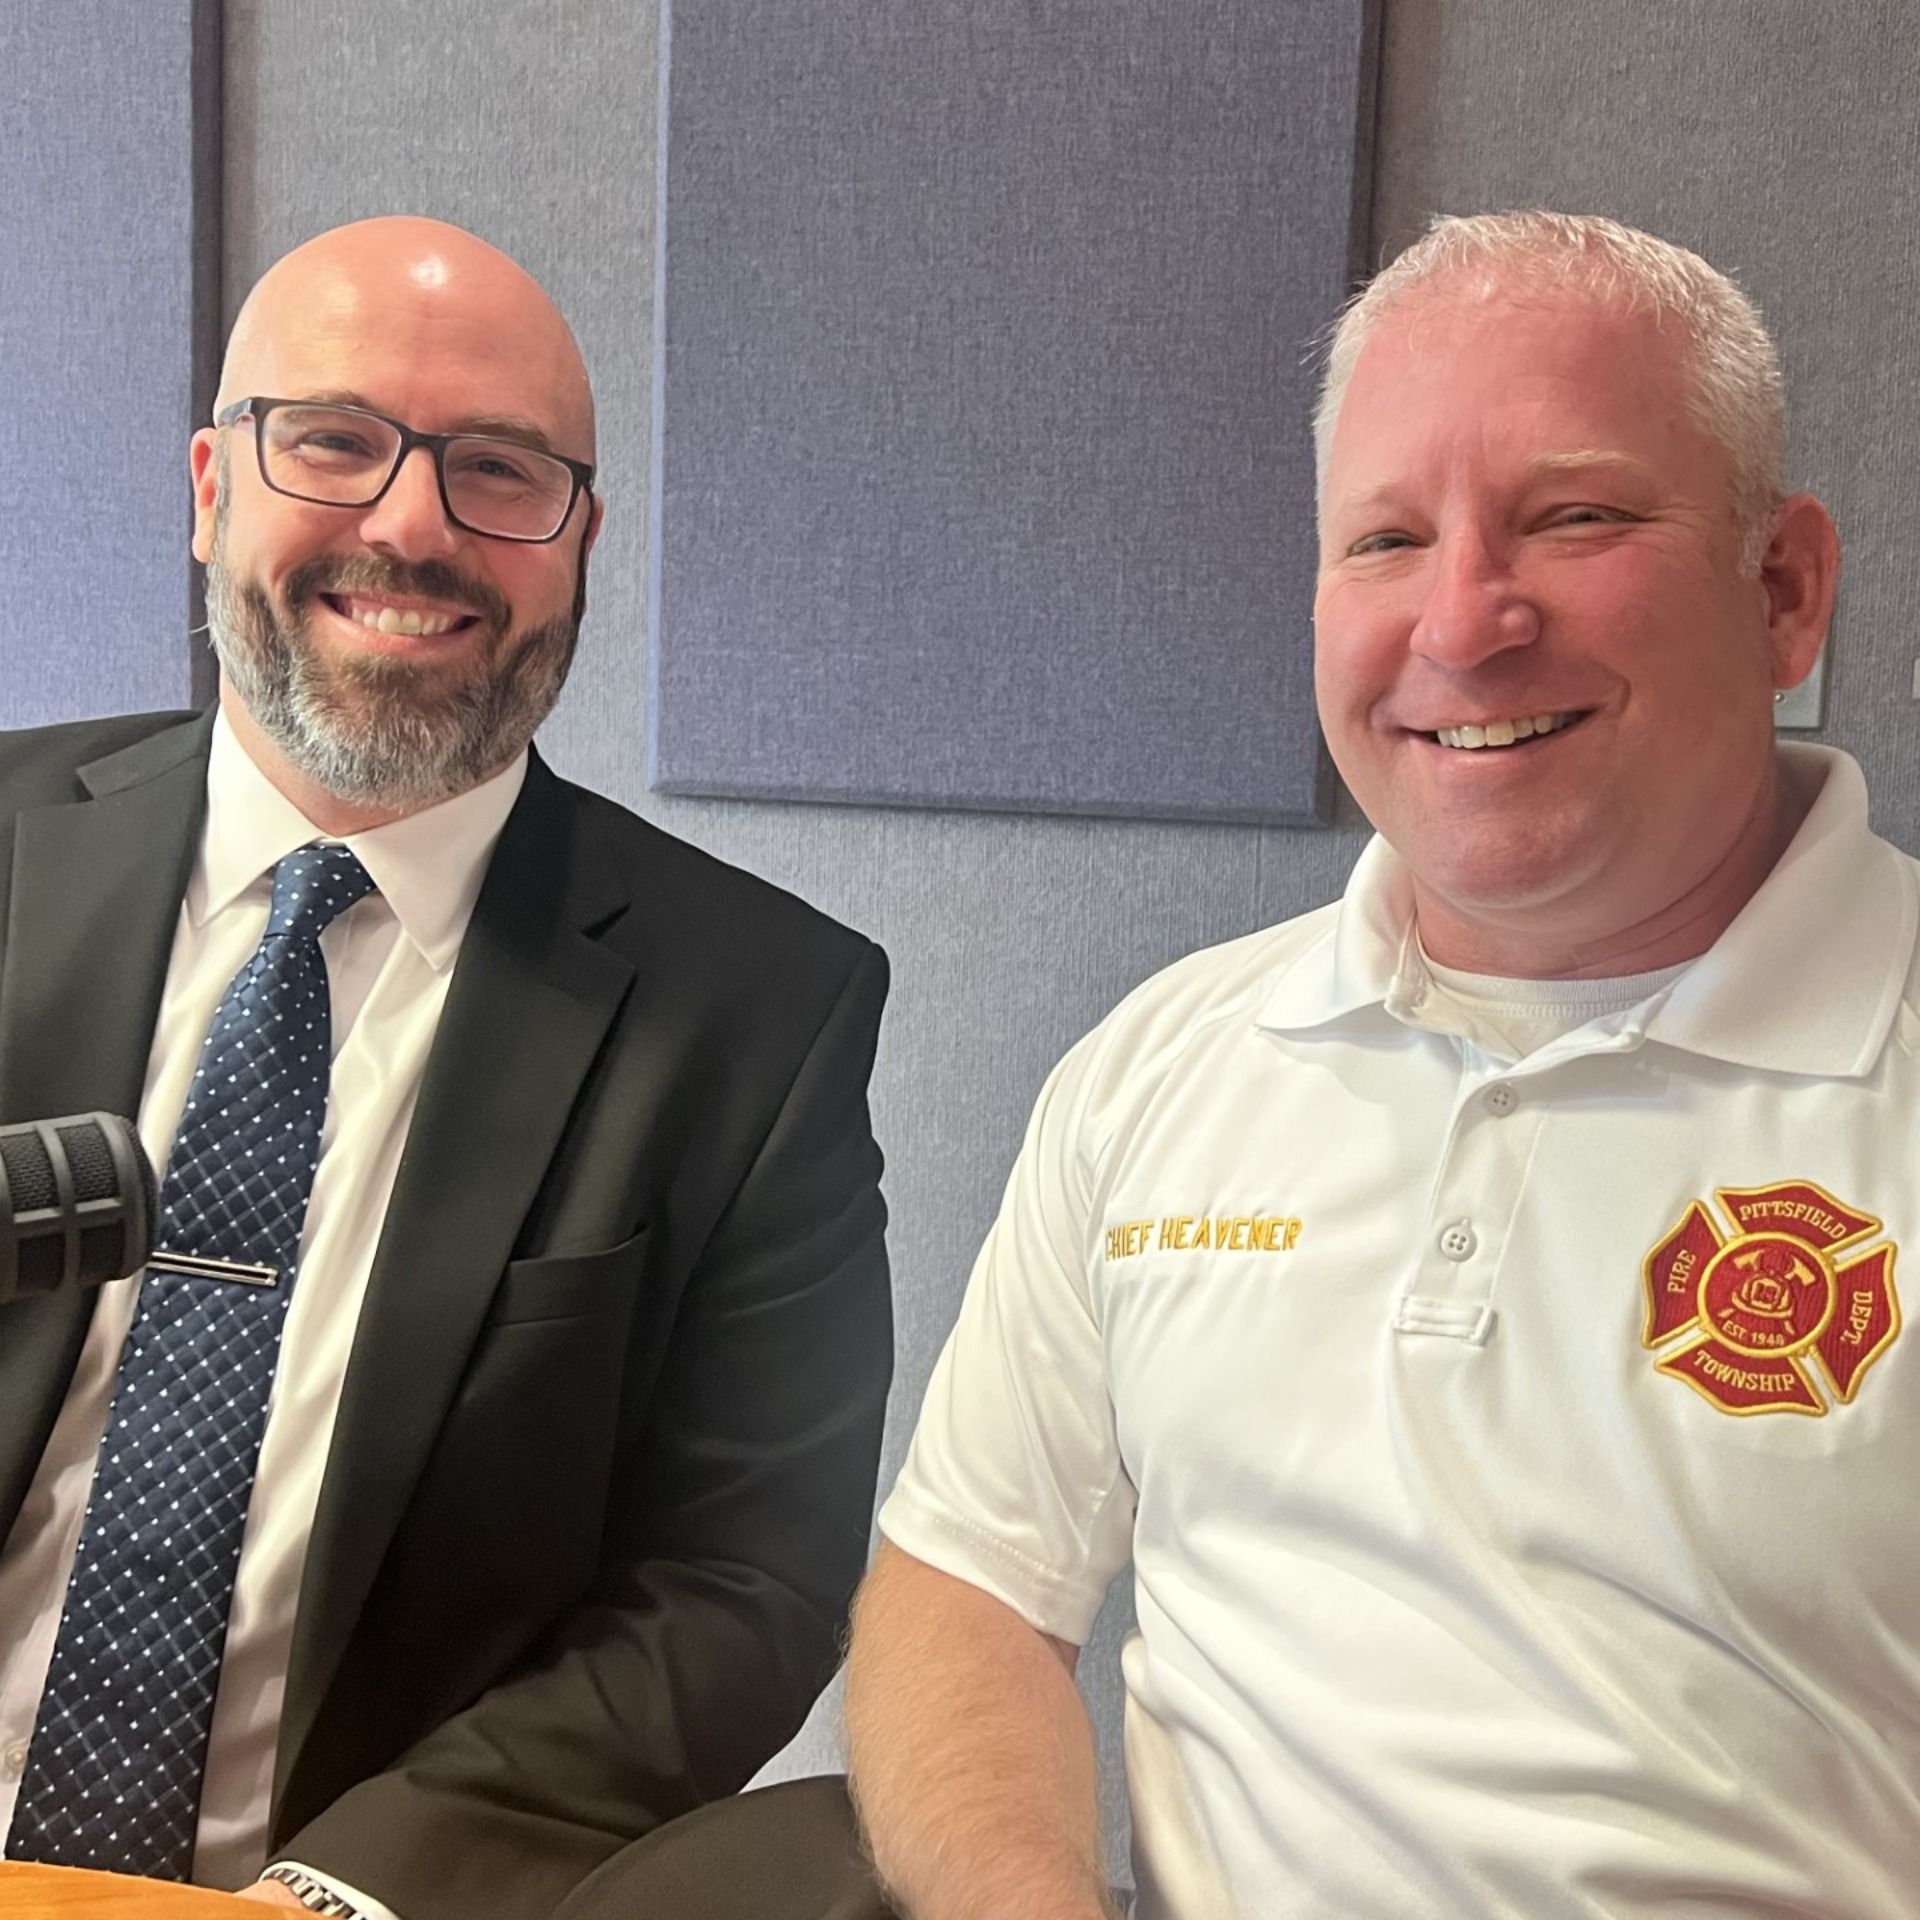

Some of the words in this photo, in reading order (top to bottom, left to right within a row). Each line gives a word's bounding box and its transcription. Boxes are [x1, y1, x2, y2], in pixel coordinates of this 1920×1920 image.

[1105, 1221, 1154, 1261] CHIEF
[1158, 1216, 1302, 1251] HEAVENER
[1739, 1201, 1847, 1240] PITTSFIELD
[1693, 1350, 1795, 1392] TOWNSHIP
